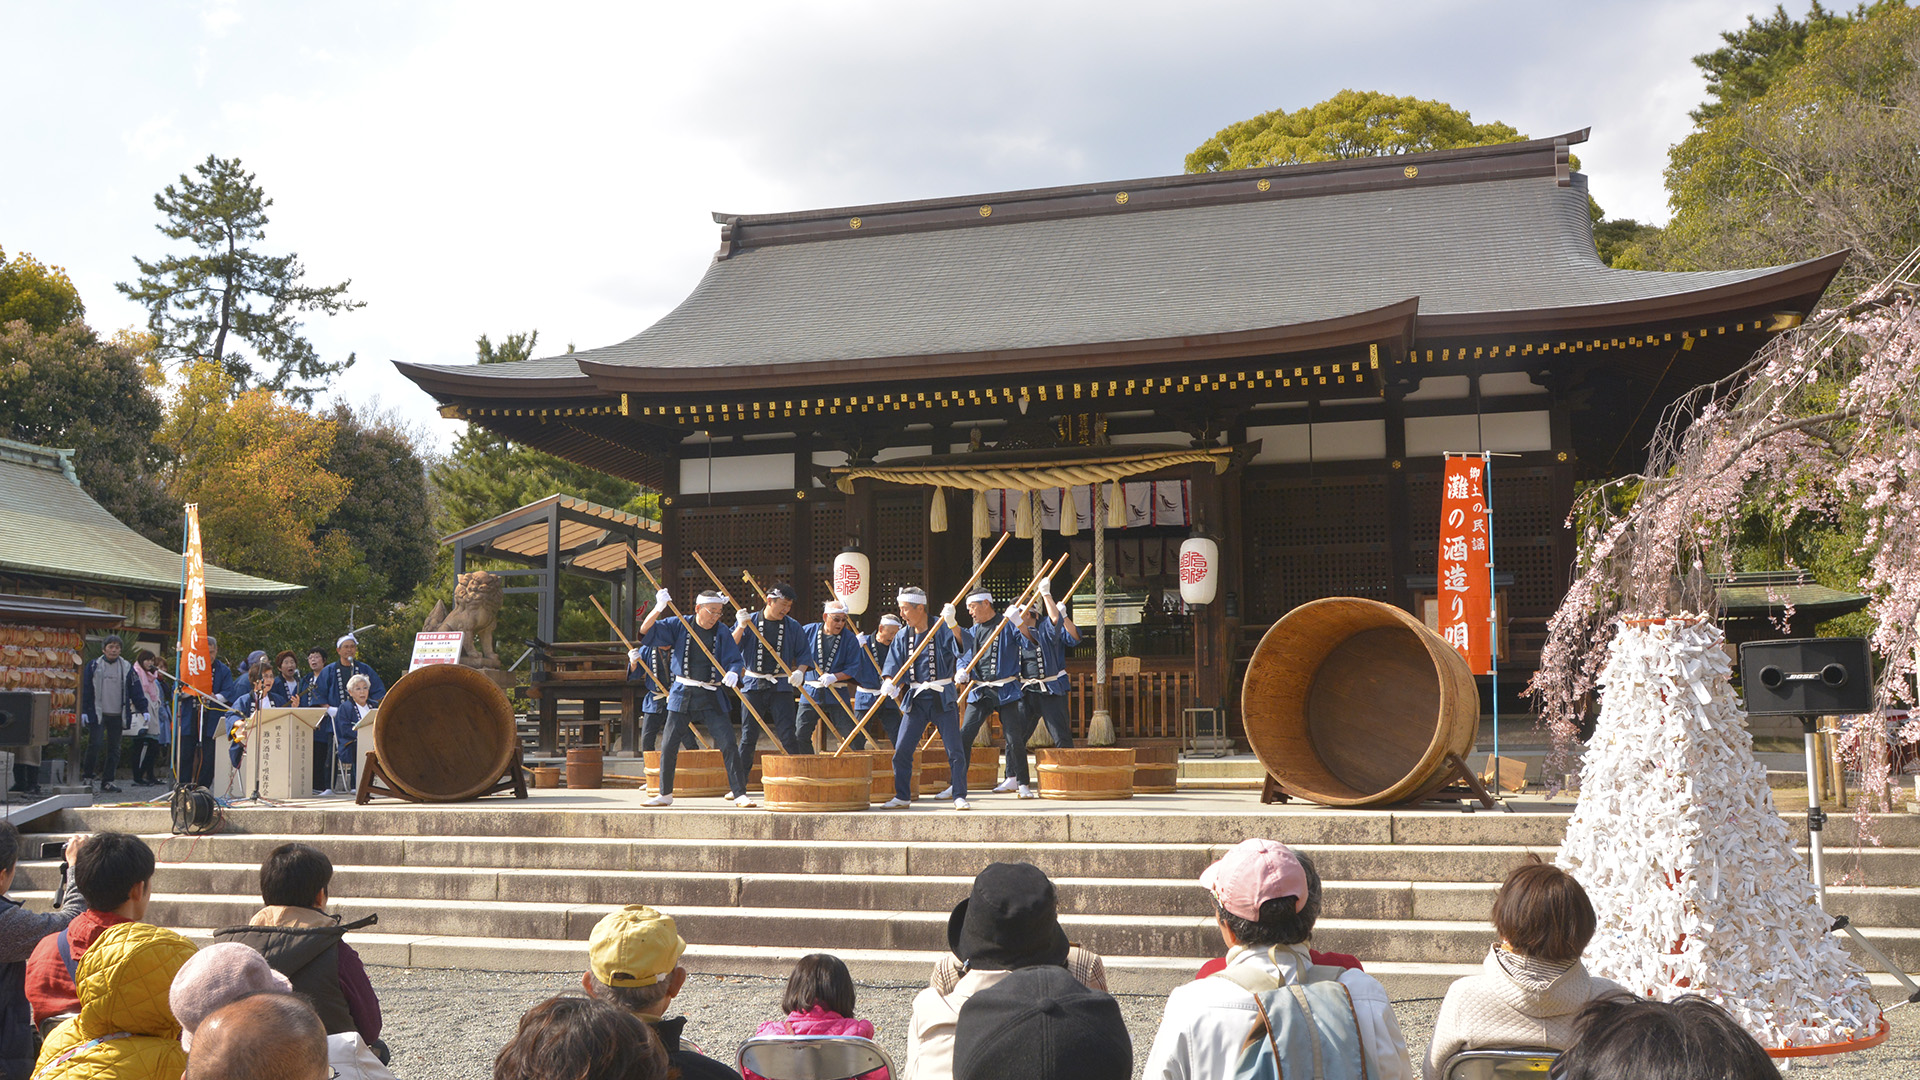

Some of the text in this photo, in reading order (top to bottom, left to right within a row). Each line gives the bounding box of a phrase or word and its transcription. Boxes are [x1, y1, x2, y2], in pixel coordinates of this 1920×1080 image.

[1443, 473, 1469, 650] 灘の酒造り唄
[1469, 466, 1486, 551] 郷土の民謡
